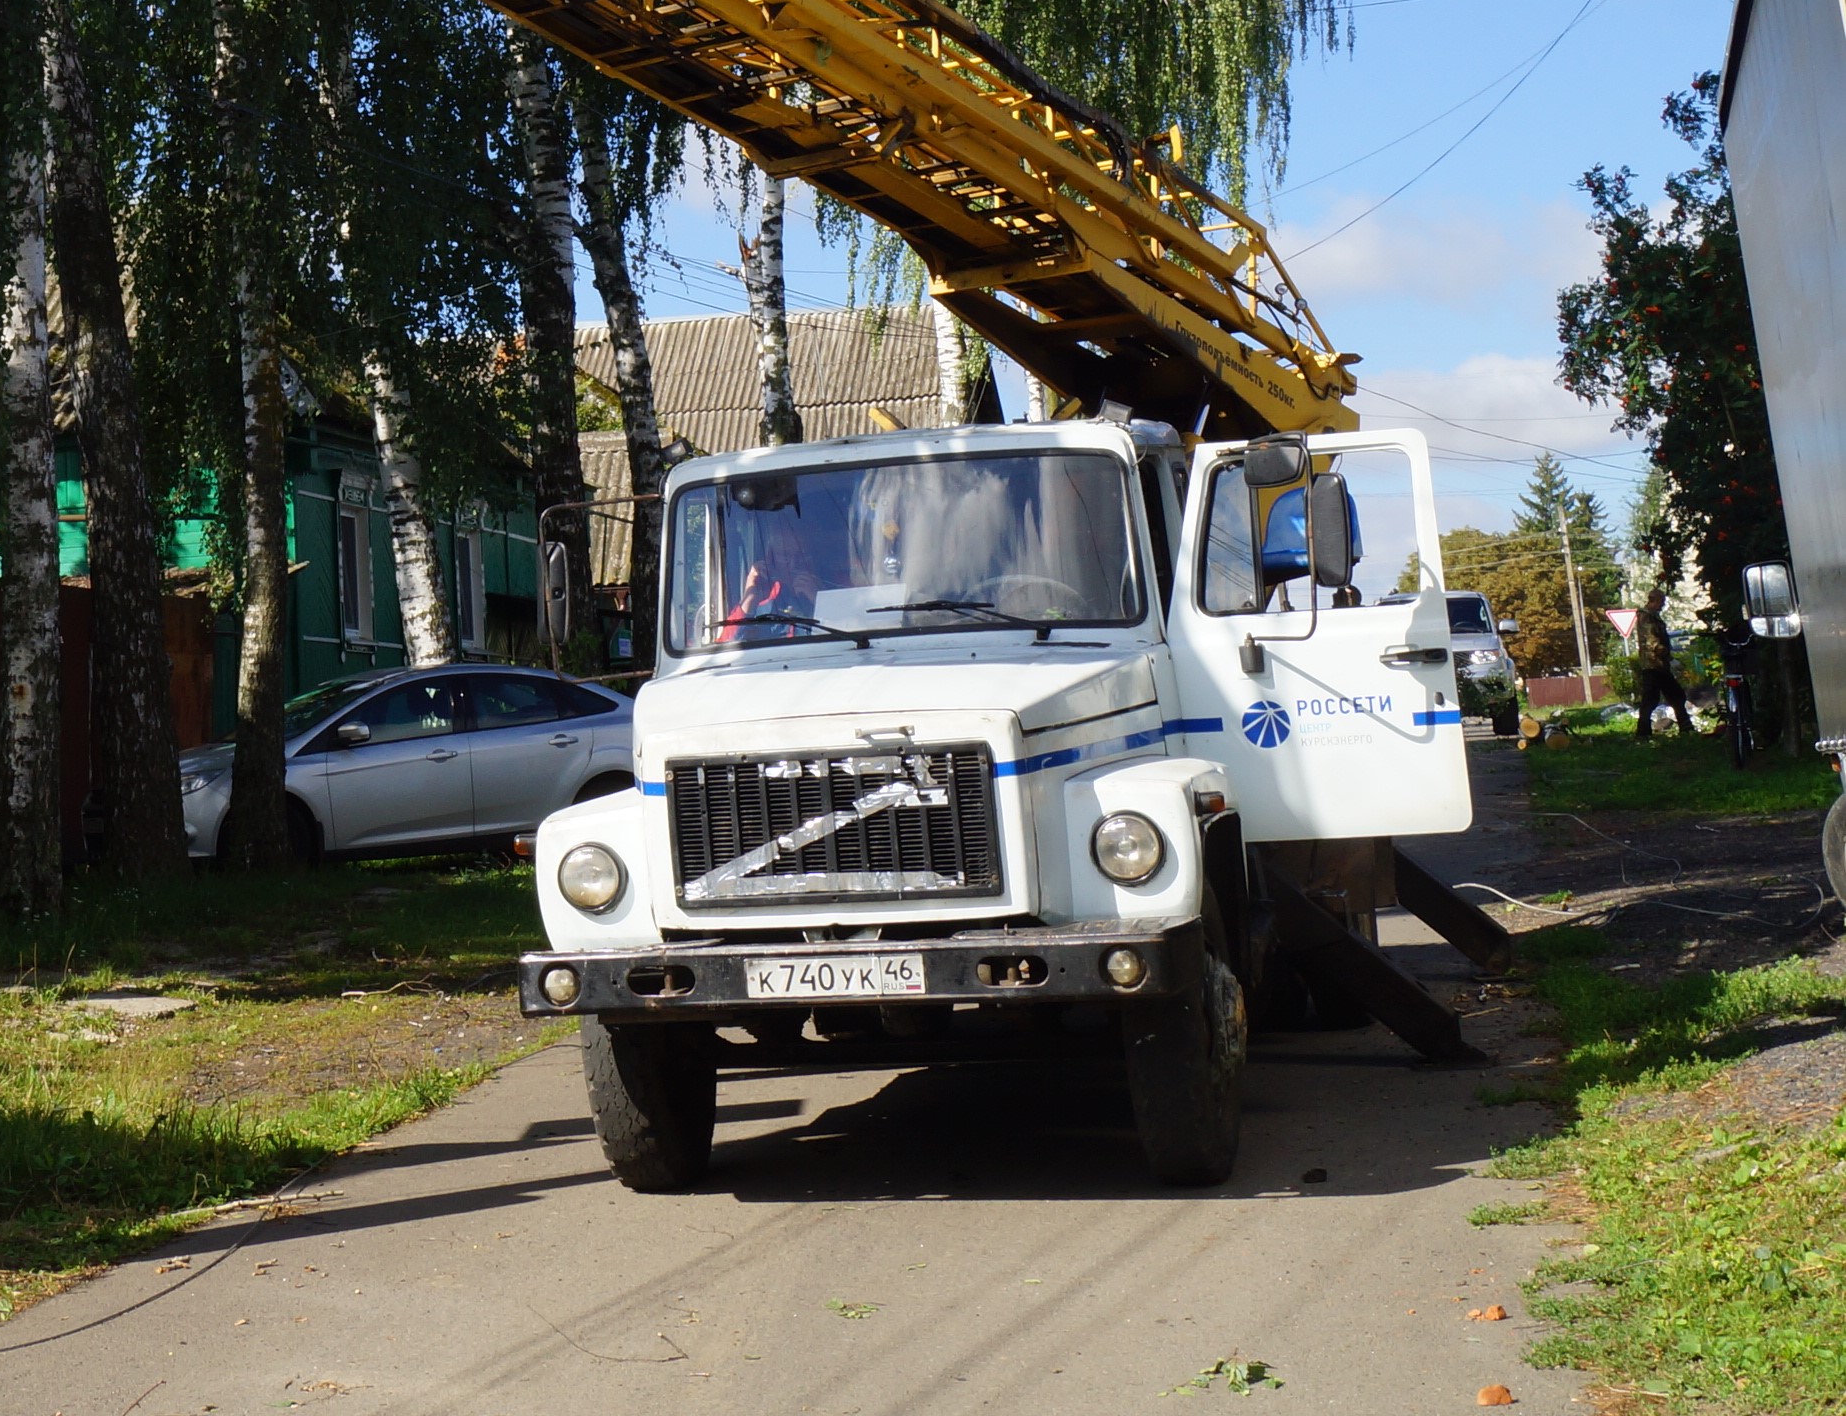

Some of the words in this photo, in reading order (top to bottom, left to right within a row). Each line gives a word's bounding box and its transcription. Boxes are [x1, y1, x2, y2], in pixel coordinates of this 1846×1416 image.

[1296, 695, 1393, 716] РОССЕТИ
[1299, 722, 1332, 734] ЦЕНТР
[1300, 734, 1374, 747] КУРСКЭНЕРГО
[884, 959, 914, 981] 46
[883, 982, 906, 991] RUS
